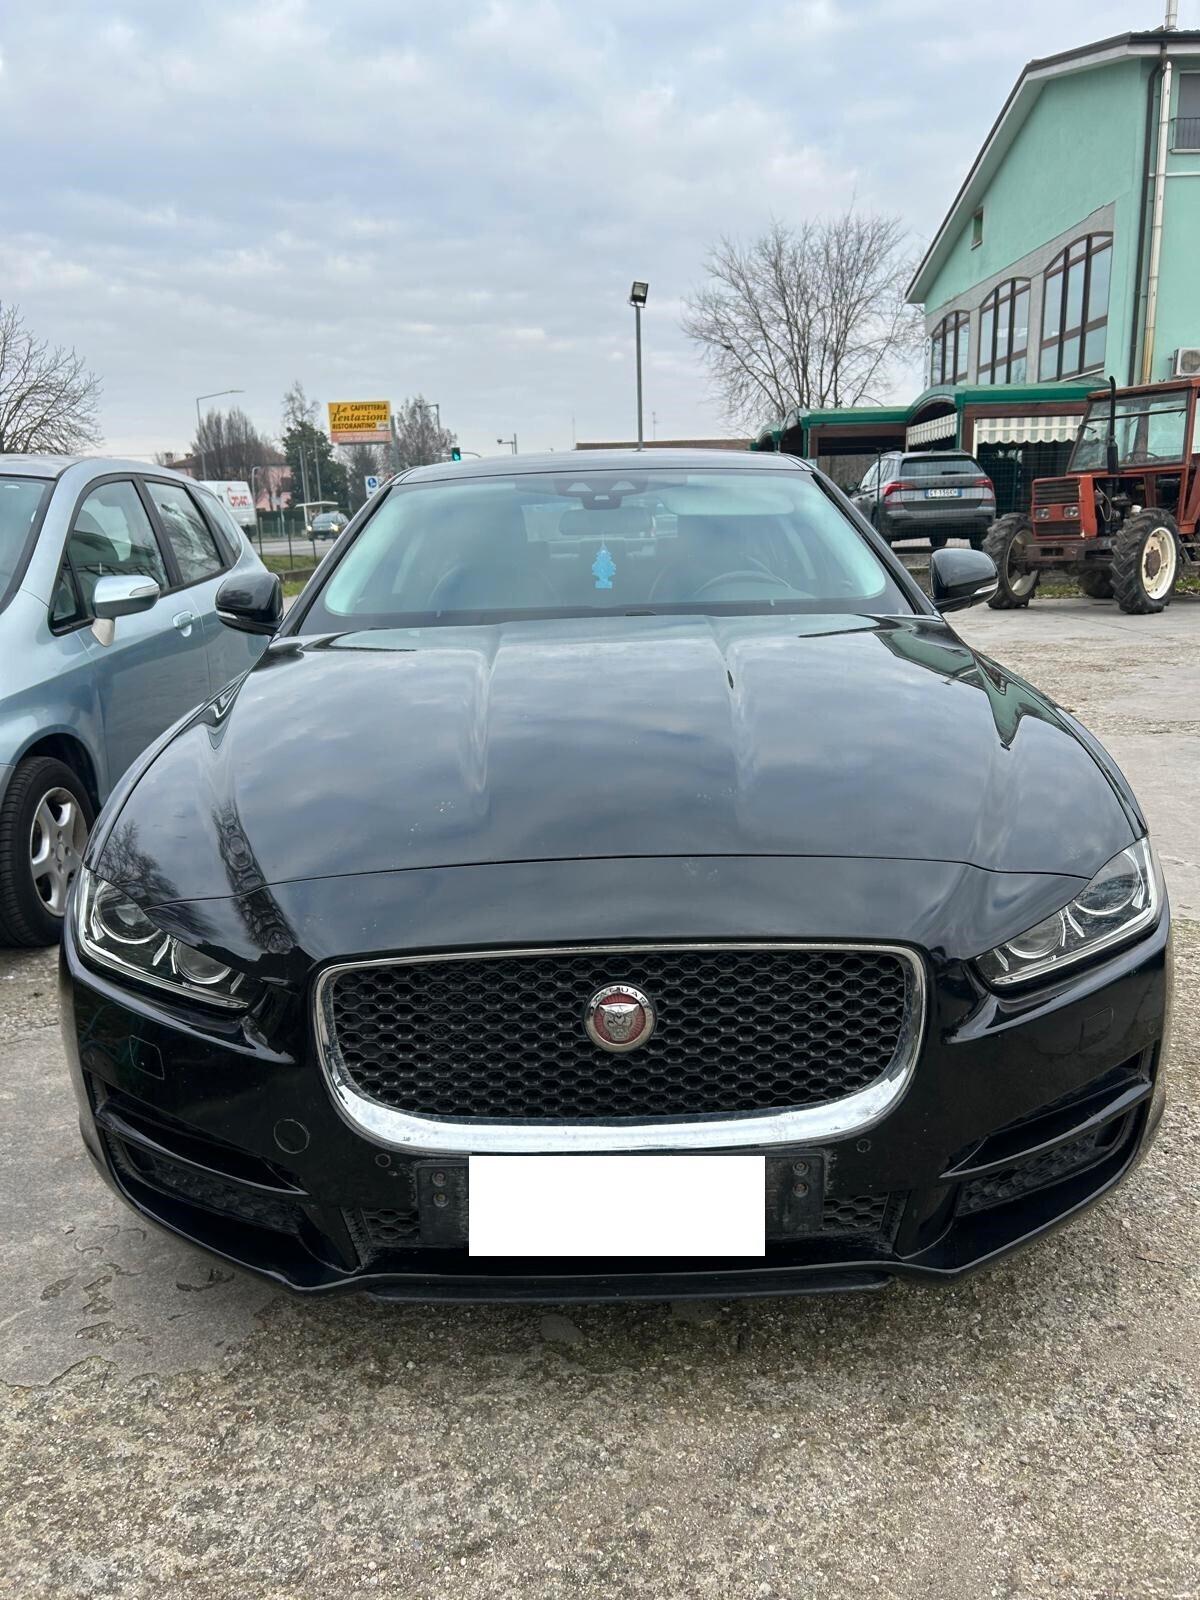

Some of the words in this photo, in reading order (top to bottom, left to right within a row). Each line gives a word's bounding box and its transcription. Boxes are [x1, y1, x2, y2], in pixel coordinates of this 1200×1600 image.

[335, 404, 347, 414] Le
[351, 403, 387, 411] CAFFETTERIA
[332, 411, 388, 422] Tentazioni
